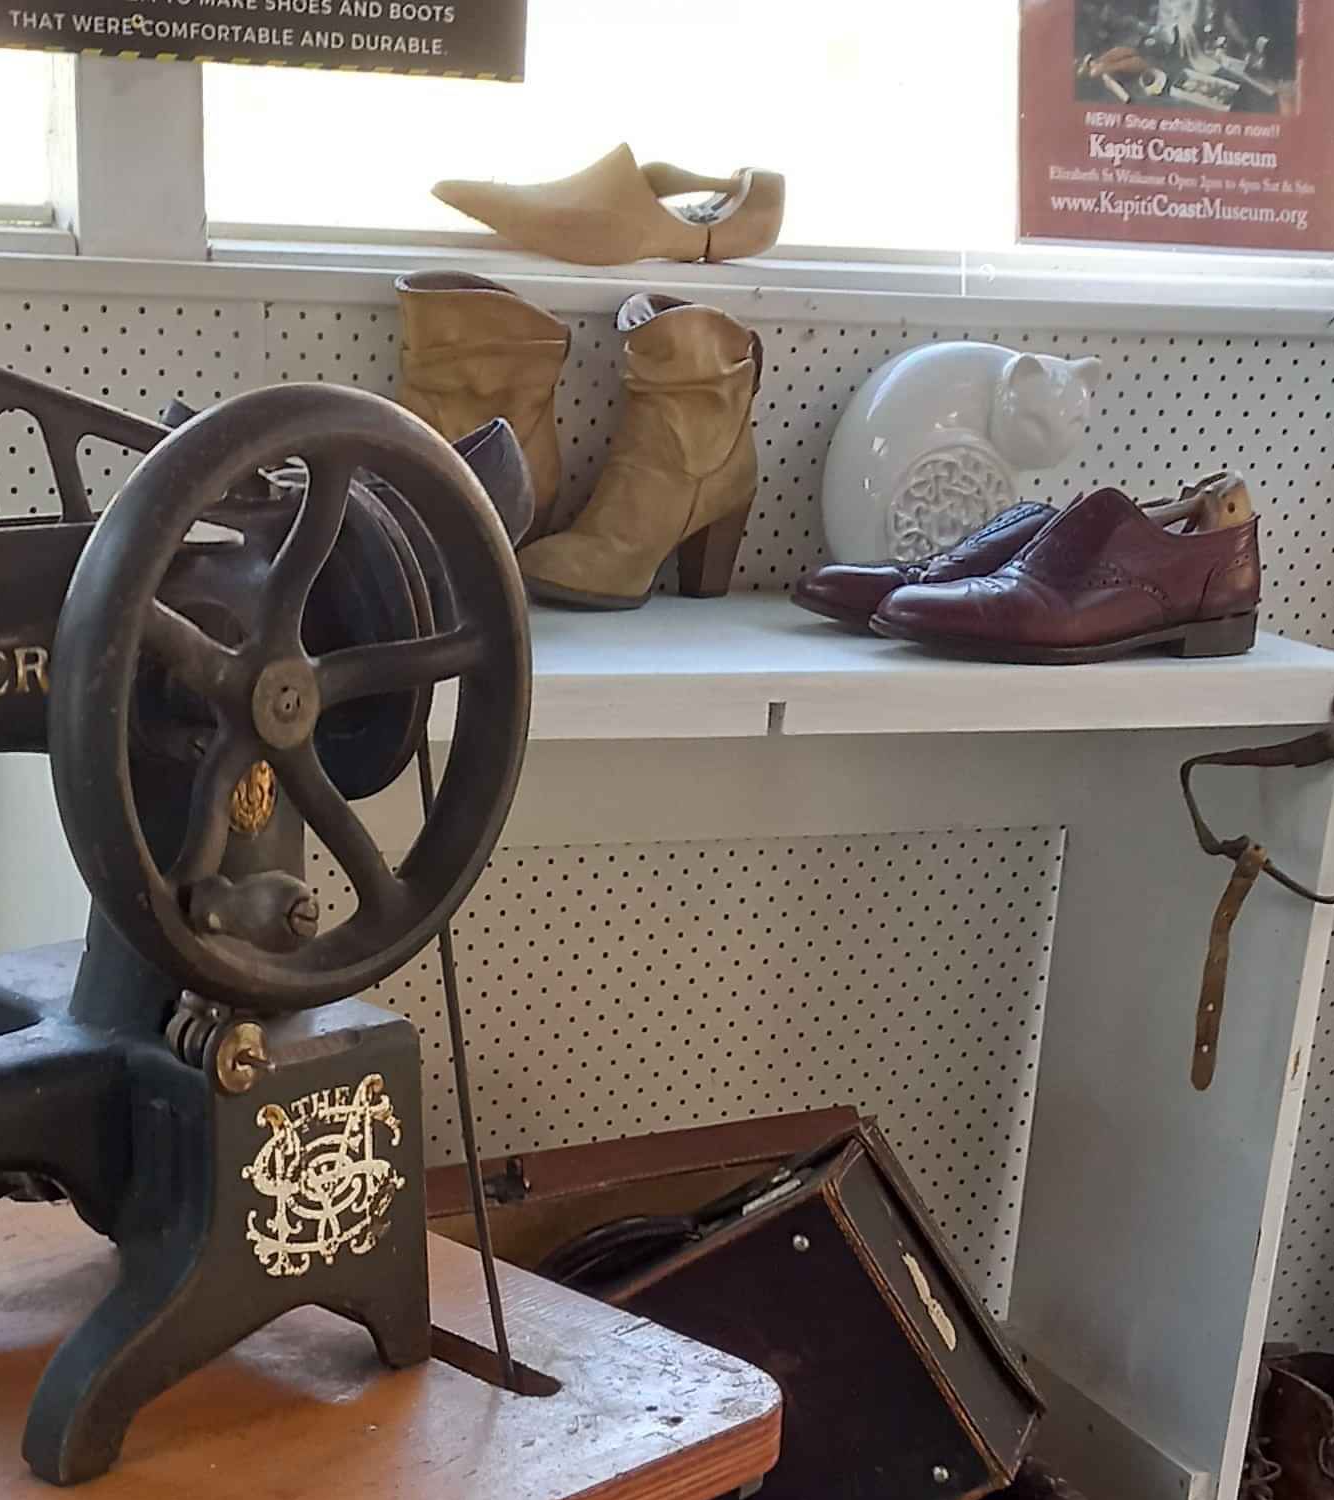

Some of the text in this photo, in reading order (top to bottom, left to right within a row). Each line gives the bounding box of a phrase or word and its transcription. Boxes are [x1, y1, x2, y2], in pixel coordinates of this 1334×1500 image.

[266, 0, 332, 15] SHOES
[339, 0, 382, 18] AND
[389, 3, 455, 22] BOOTS
[8, 10, 449, 56] THAT WERE COMFORTABLE AND DURABLE.
[1084, 111, 1121, 128] NEW!
[1124, 114, 1156, 131] Shoe
[1225, 123, 1242, 137] on
[1089, 133, 1278, 169] Kapiti Coast Museum
[1050, 190, 1309, 231] www.KapitiCoastMuseum.org
[290, 1085, 350, 1127] THE
